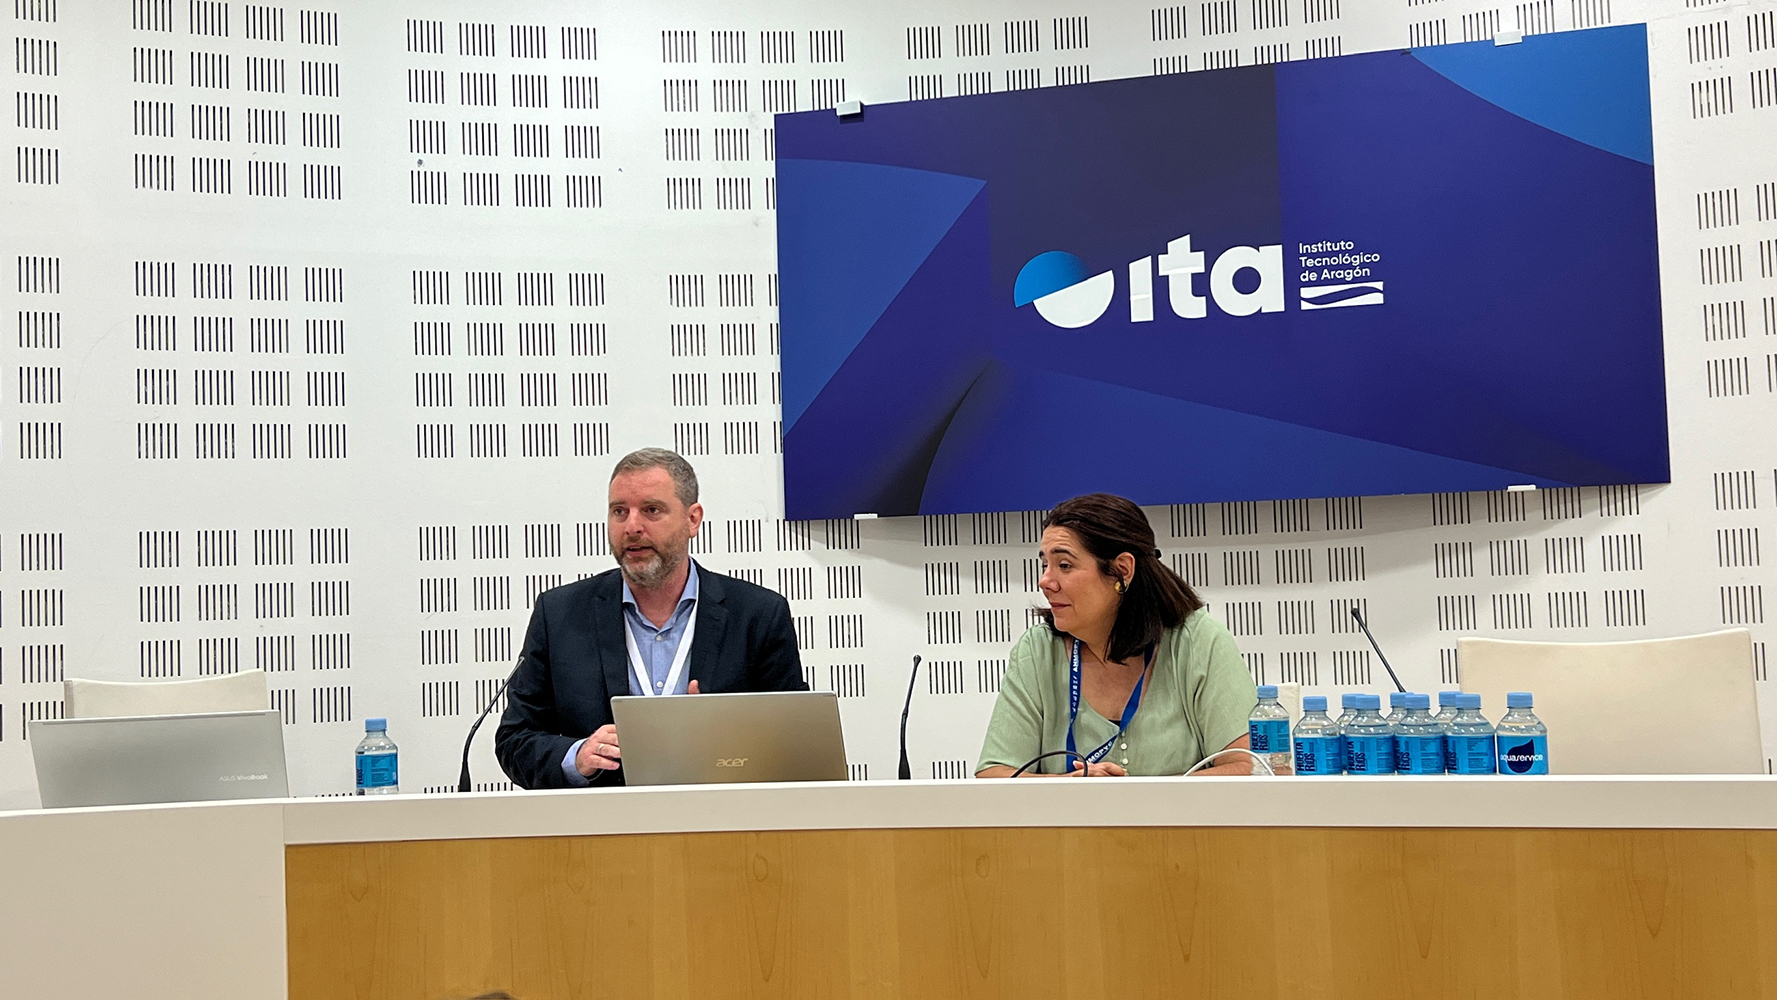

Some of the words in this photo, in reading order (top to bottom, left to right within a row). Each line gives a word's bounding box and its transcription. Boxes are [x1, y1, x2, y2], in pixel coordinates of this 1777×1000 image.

[1299, 240, 1355, 254] Instituto
[1299, 252, 1380, 268] Tecnológico
[1300, 270, 1318, 282] de
[1321, 266, 1371, 281] Aragón
[716, 758, 748, 767] acer
[1296, 742, 1304, 772] HUERTA
[236, 773, 268, 781] VivoBook
